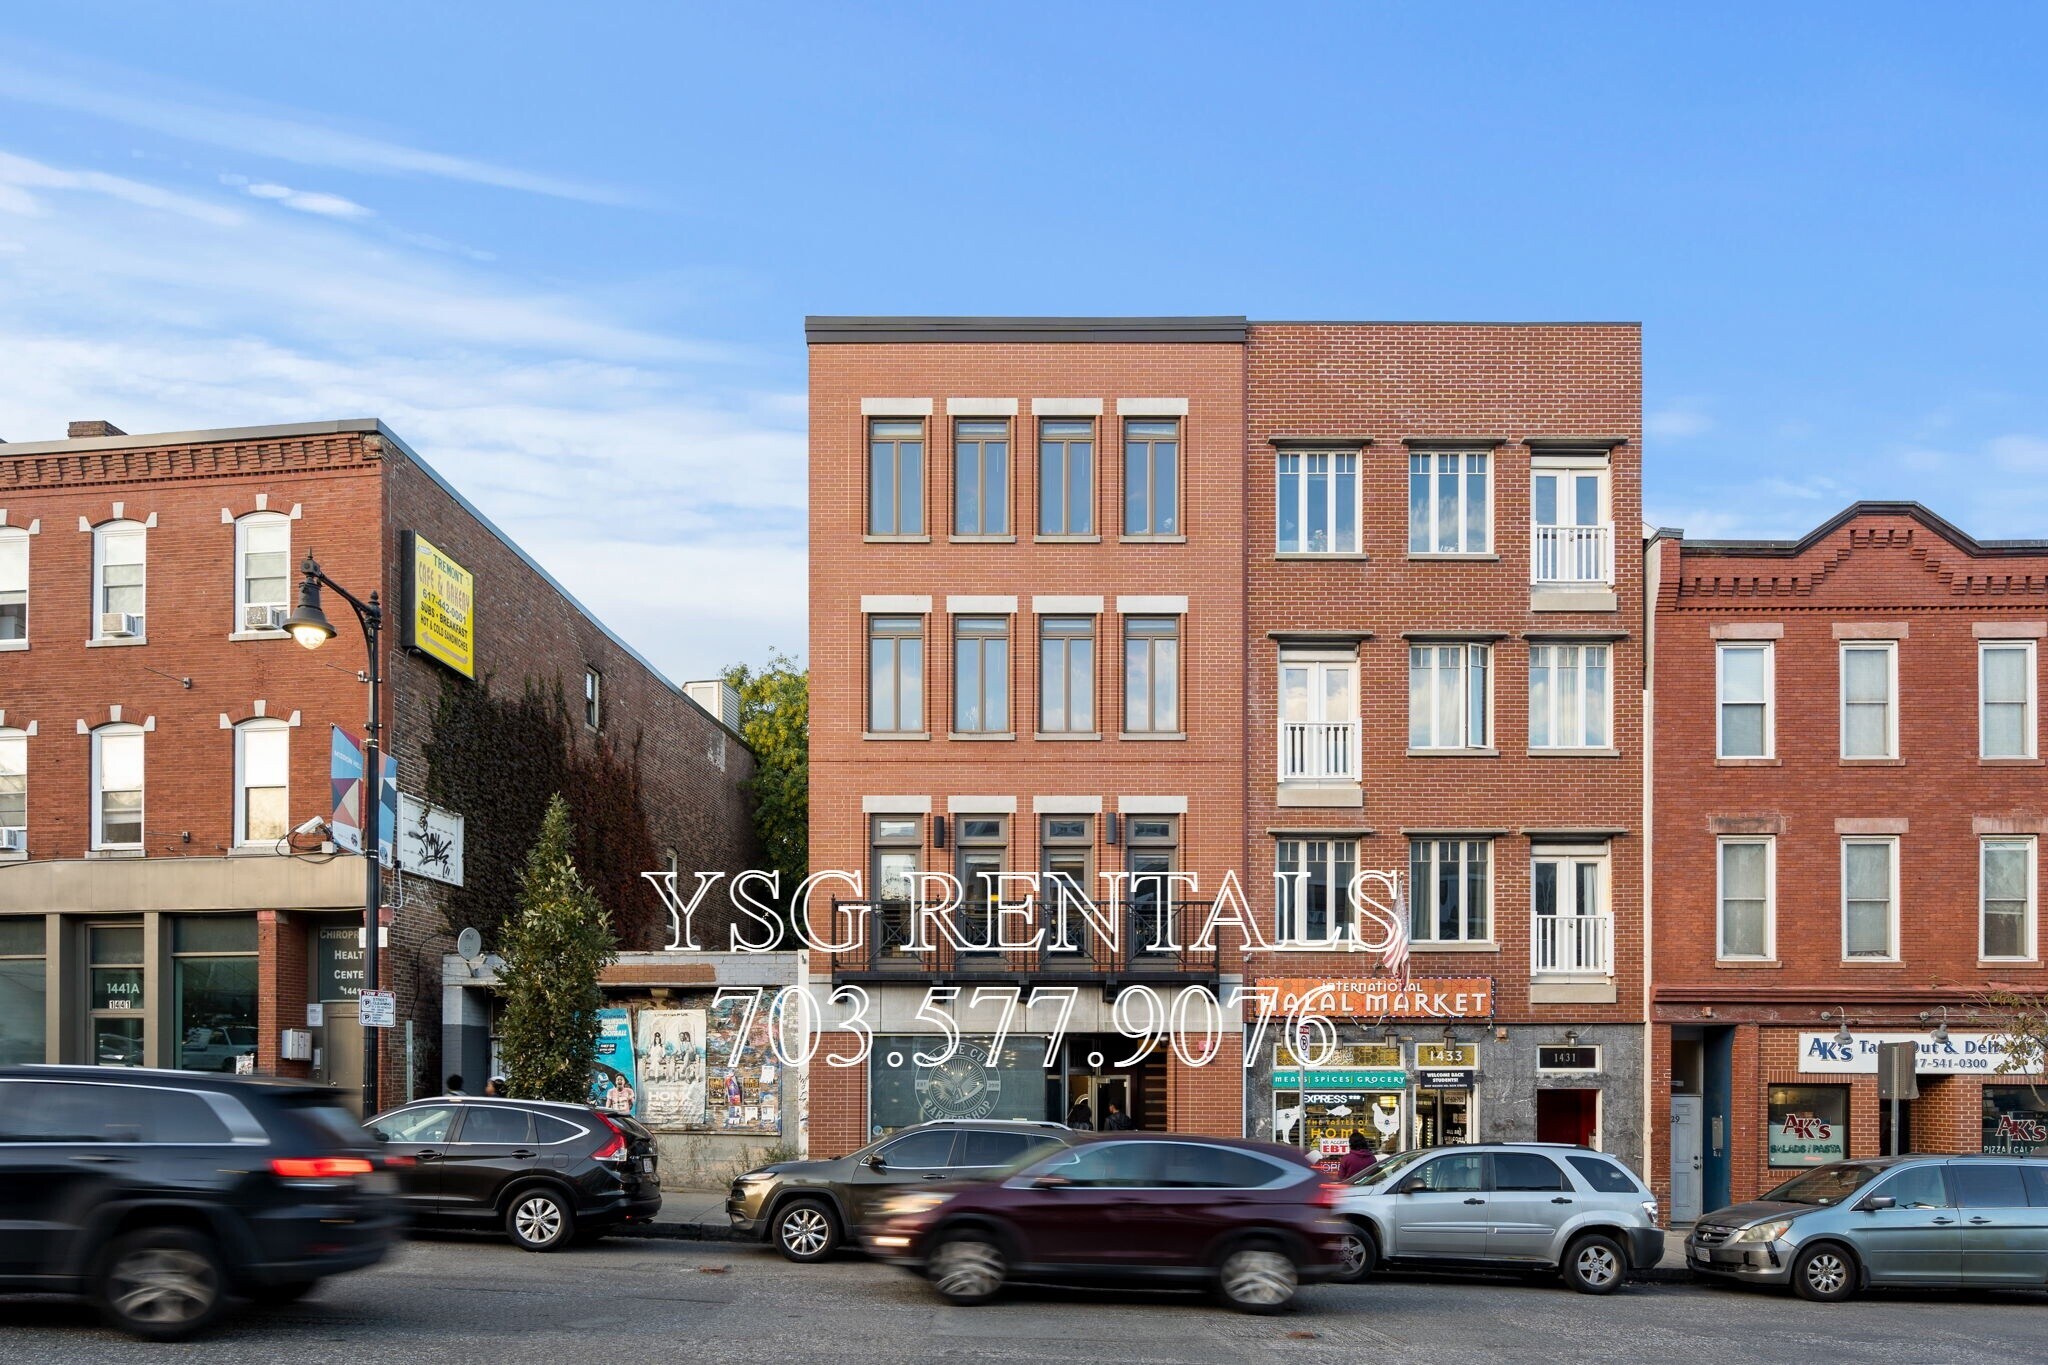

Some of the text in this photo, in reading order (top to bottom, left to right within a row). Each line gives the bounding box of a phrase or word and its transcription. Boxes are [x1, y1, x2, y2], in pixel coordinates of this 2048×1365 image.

[433, 553, 464, 585] TREMONT
[420, 600, 468, 640] SUBS BREAKFAST
[334, 950, 365, 960] HEALT
[334, 970, 364, 979] CENTE
[106, 983, 140, 994] 1441A
[109, 1000, 131, 1009] 1441
[1366, 993, 1487, 1016] MARKET
[1808, 1037, 1854, 1062] AK's
[1430, 1050, 1463, 1062] 1433
[1554, 1053, 1576, 1063] 1431
[1915, 1058, 1988, 1069] 17-541-0300
[1314, 1075, 1350, 1084] SPICES
[1357, 1076, 1405, 1085] GROCERY
[1781, 1113, 1833, 1141] AK's
[1995, 1114, 2047, 1142] AK's
[1322, 1144, 1349, 1153] EBT
[1812, 1144, 1842, 1154] PASTA
[1983, 1145, 2006, 1154] PIZZA
